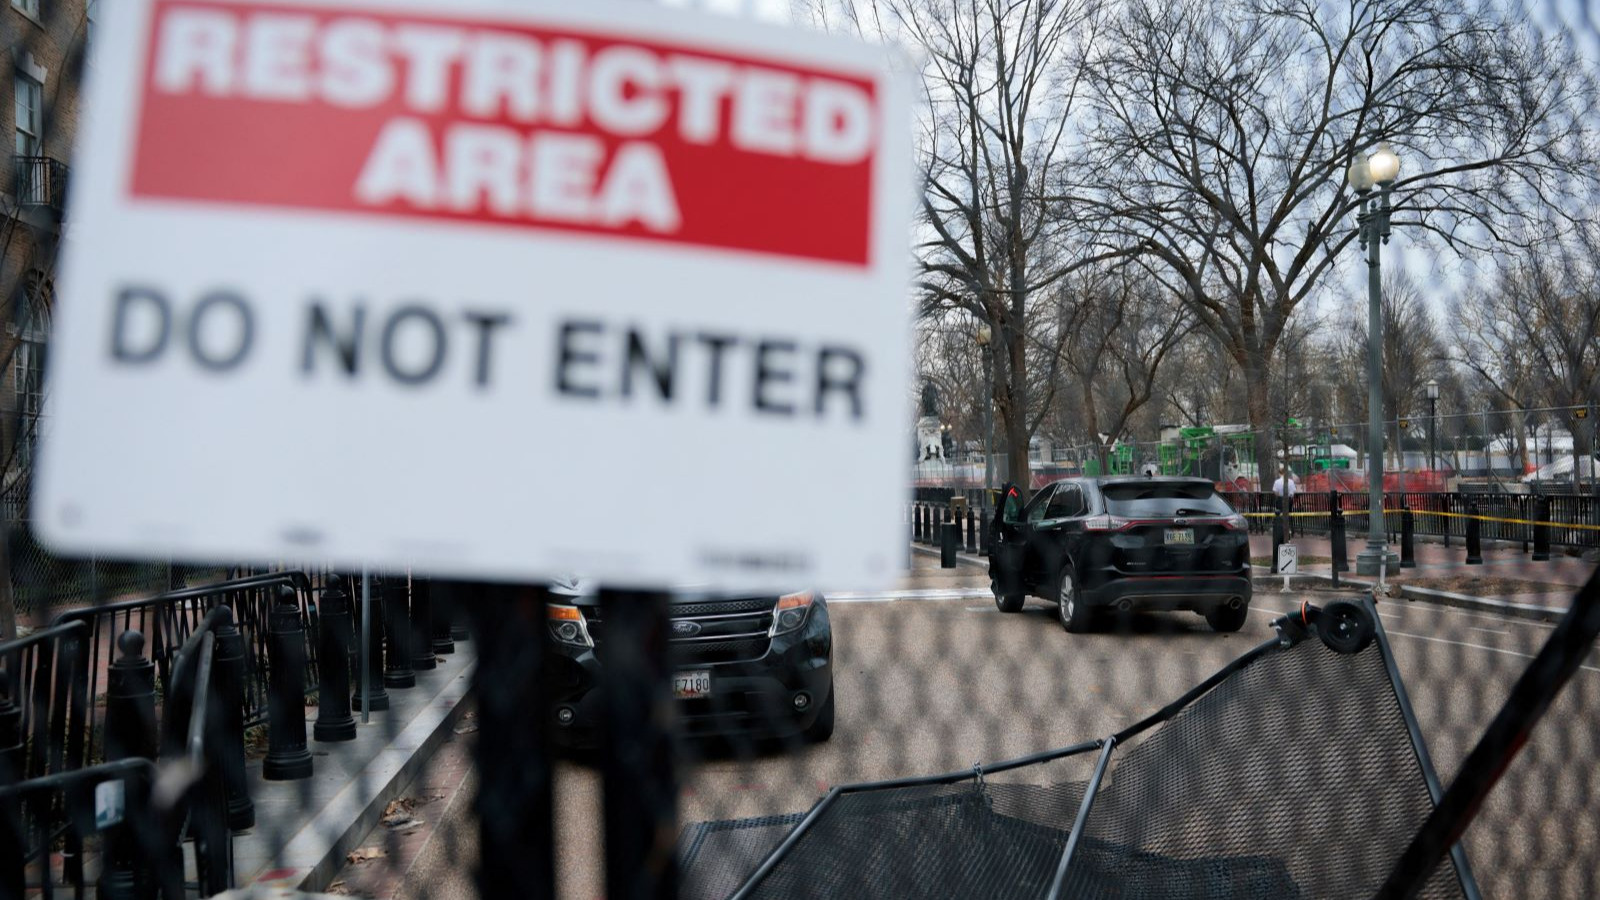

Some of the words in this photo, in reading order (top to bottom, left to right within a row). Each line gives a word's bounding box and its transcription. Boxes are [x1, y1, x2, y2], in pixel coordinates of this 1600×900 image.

[157, 10, 873, 163] RESTRICTED
[355, 118, 680, 231] AREA
[107, 284, 255, 373] DO
[299, 299, 512, 389] NOT
[551, 318, 867, 420] ENTER
